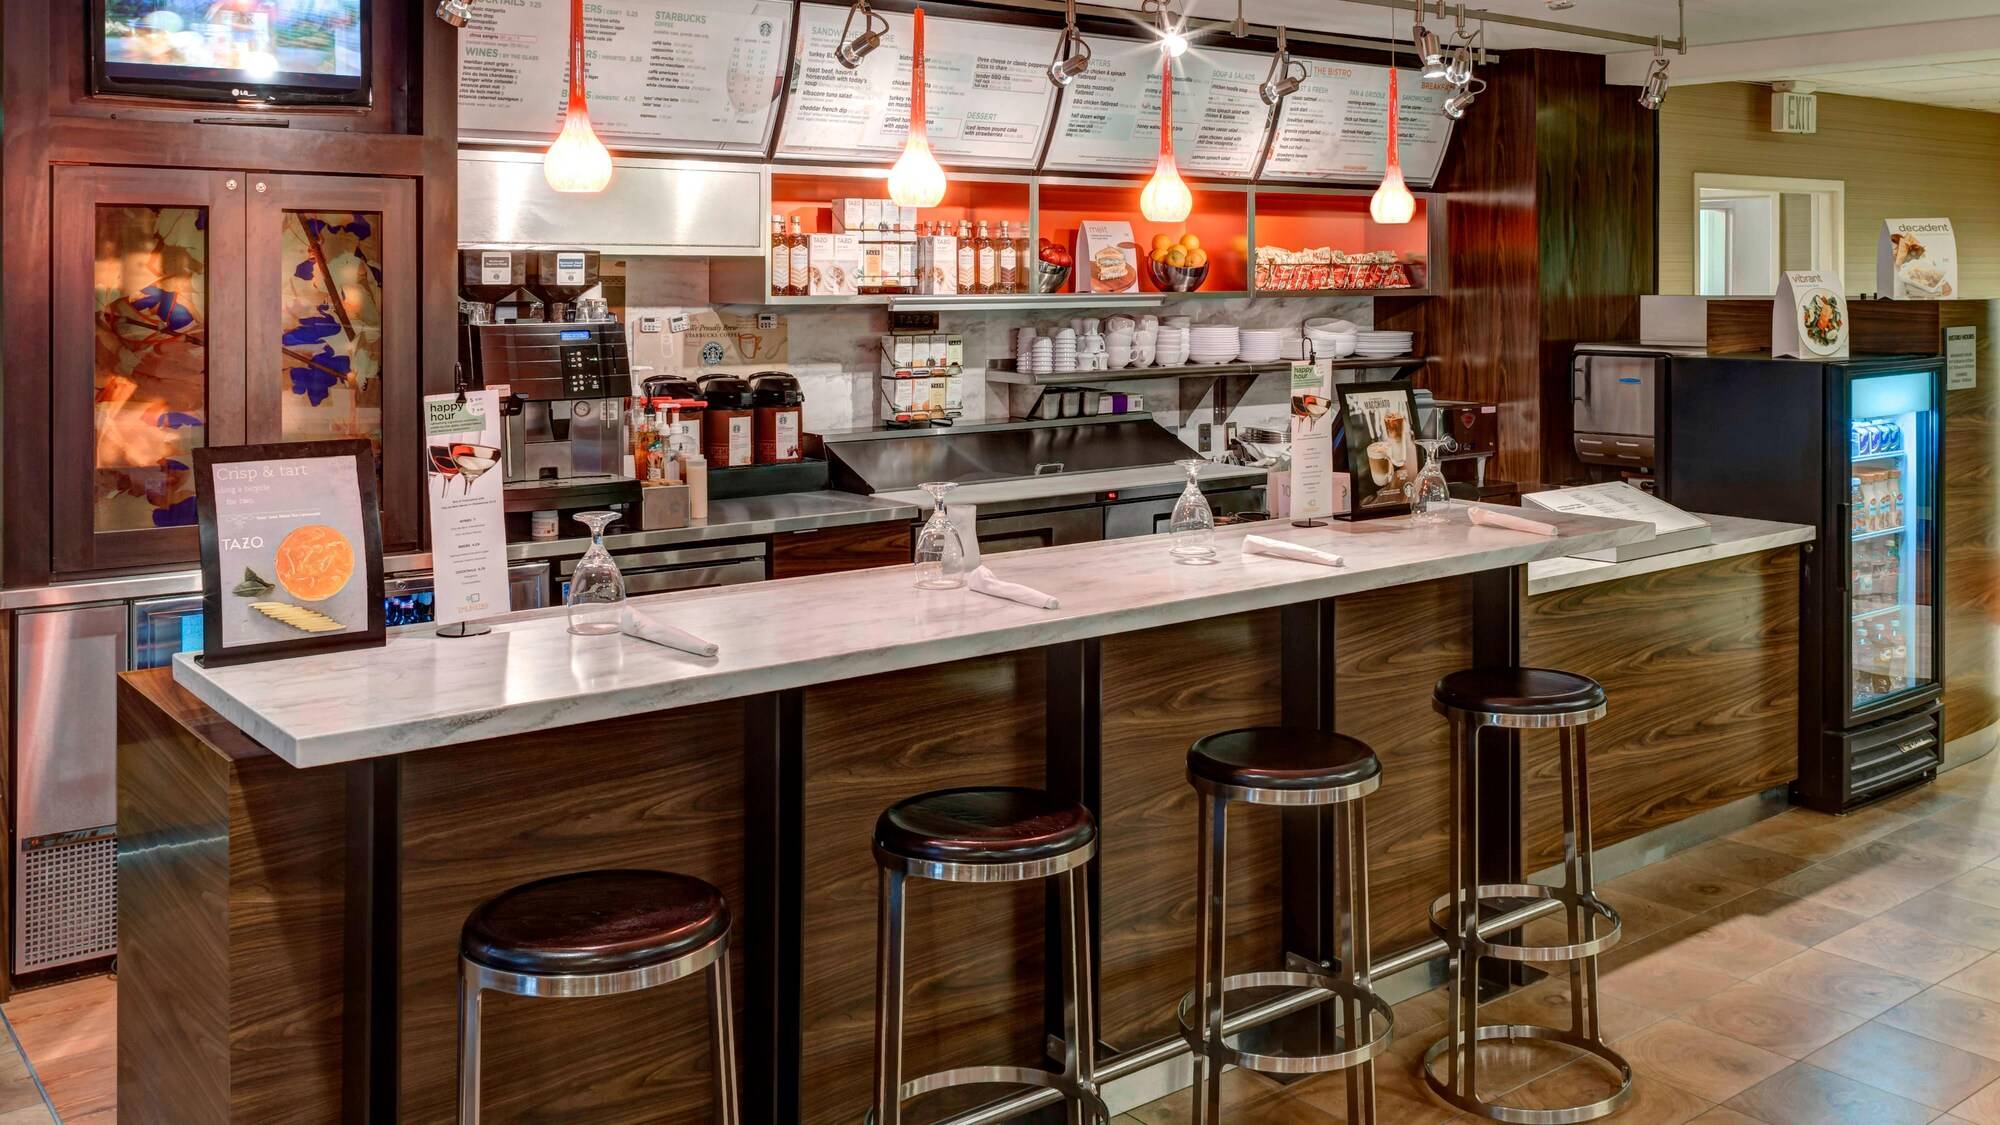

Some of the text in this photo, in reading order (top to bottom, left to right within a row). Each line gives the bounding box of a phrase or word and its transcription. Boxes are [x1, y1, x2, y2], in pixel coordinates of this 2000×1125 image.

[655, 10, 706, 24] STARBUCKS
[465, 46, 498, 58] WINES
[1328, 67, 1352, 77] BISTRO
[967, 111, 998, 120] DESSERT
[1788, 95, 1812, 132] EXIT
[1898, 223, 1950, 232] decadent
[1792, 274, 1824, 283] vibrant
[700, 324, 721, 332] Proudly
[1294, 366, 1314, 375] happy
[430, 402, 464, 412] happy
[1364, 400, 1390, 409] MACCHIATO
[430, 412, 456, 422] hour
[216, 464, 308, 482] Crisp & tart
[222, 536, 264, 552] TAZO
